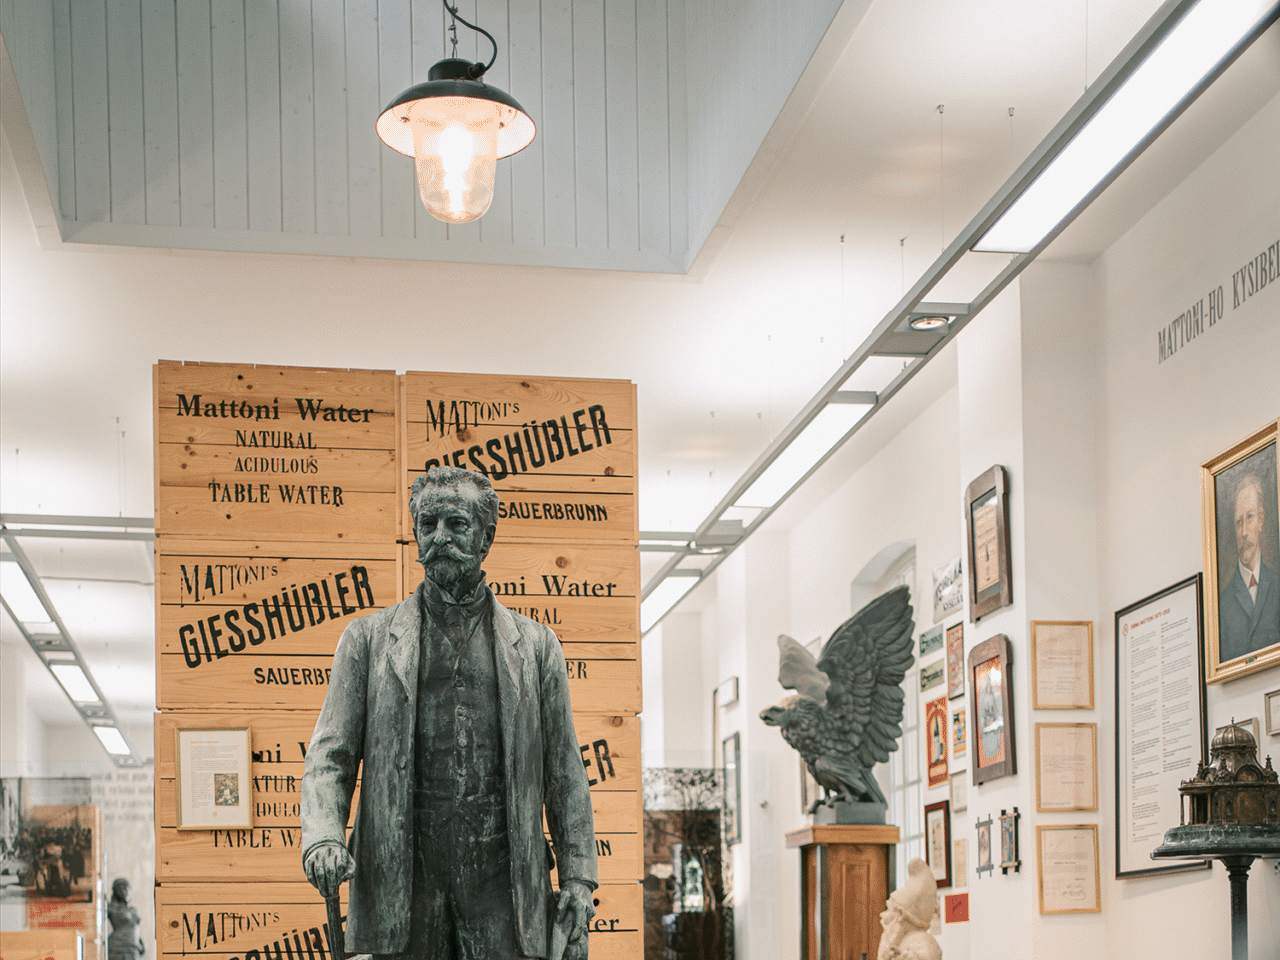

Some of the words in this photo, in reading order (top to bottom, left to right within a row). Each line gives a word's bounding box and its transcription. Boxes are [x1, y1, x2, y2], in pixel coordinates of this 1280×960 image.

[1158, 285, 1224, 364] MATTONI-HO
[176, 394, 280, 421] Mattoni
[294, 398, 374, 423] Water
[426, 400, 520, 442] MATTONI'S
[235, 430, 317, 450] NATURAL
[234, 456, 319, 474] ACIDULOUS
[209, 482, 270, 504] TABLE
[279, 484, 344, 506] WATER
[498, 501, 608, 521] SAUERBRUNN
[180, 564, 278, 608] MATTONI'S
[541, 575, 617, 598] Water
[179, 566, 375, 669] GIESSHÜBLER
[210, 829, 271, 848] TABLE
[182, 912, 280, 957] MATTONI'S
